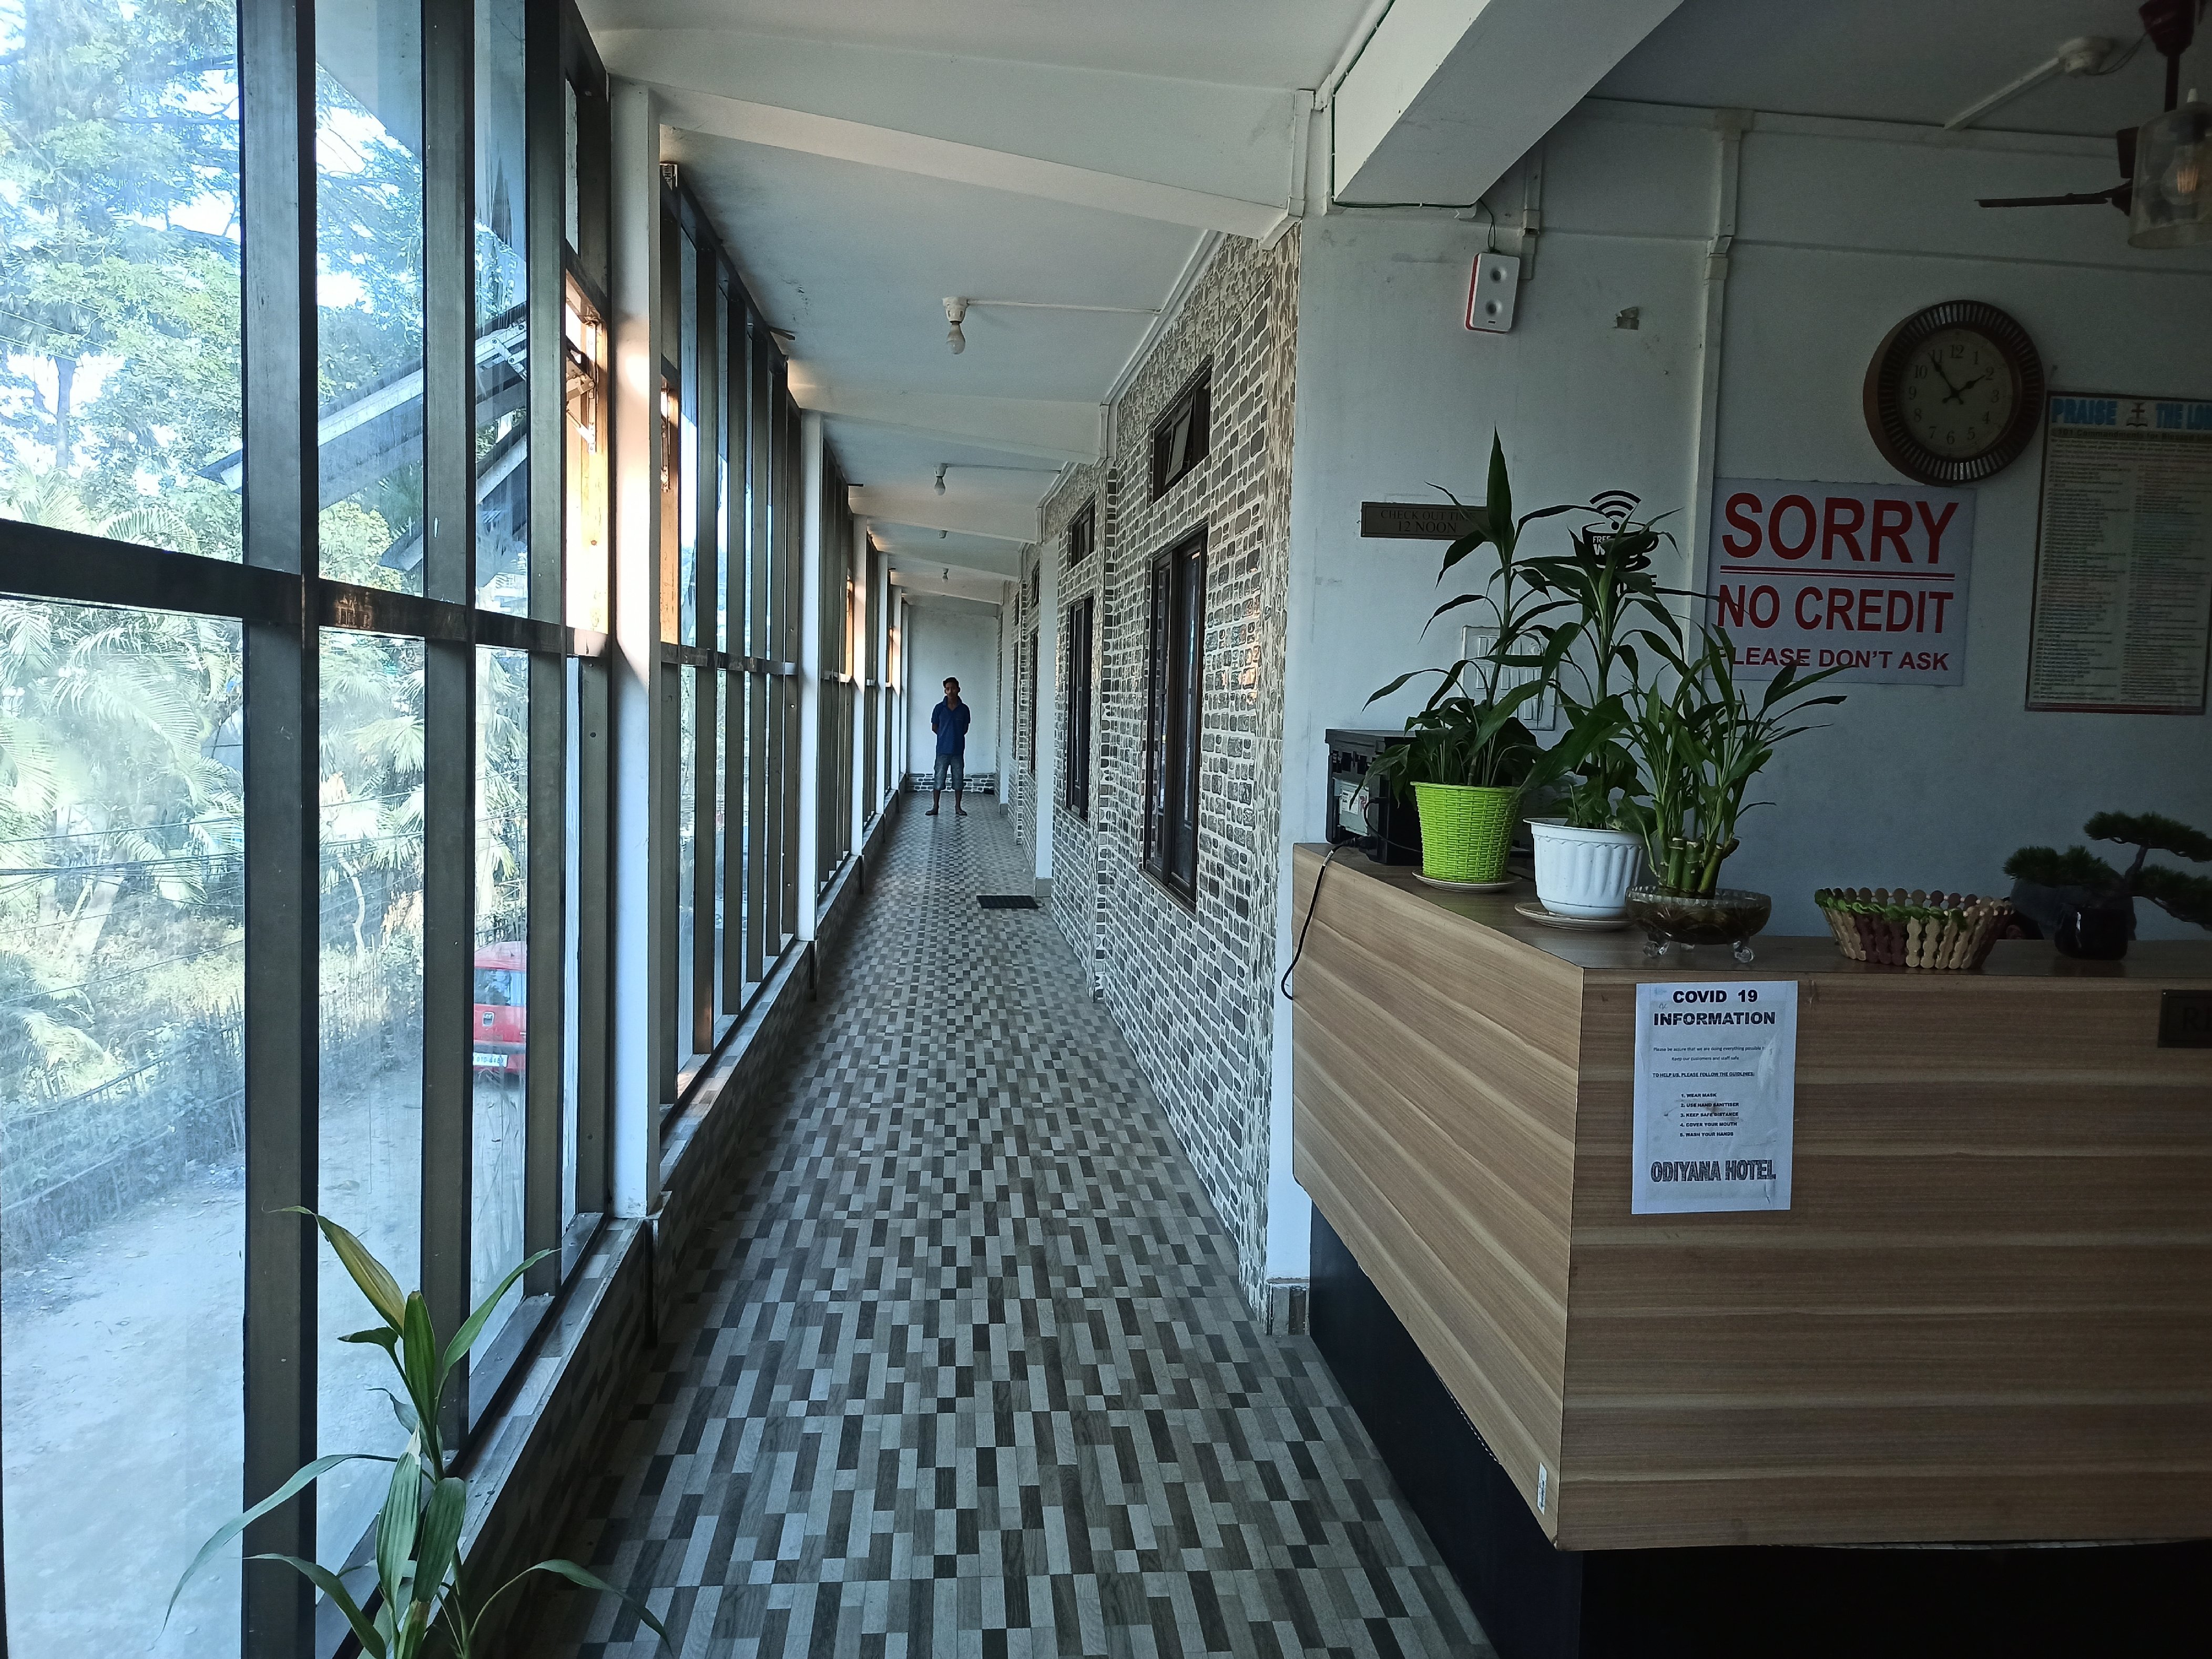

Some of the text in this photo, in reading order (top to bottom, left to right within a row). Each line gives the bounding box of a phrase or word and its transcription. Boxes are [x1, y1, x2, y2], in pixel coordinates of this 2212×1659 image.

[1950, 344, 1964, 358] 12
[1914, 364, 1928, 379] 10
[2051, 398, 2117, 425] PRAISE
[2156, 403, 2183, 429] THE
[2077, 429, 2144, 439] Commandments
[1380, 510, 1421, 520] CHECK
[1422, 511, 1445, 521] OUT
[1399, 521, 1456, 533] 12 NOON
[1722, 492, 1959, 564] SORRY
[1718, 585, 1953, 633] NO CREDIT
[1819, 649, 1893, 669] DON'T
[1898, 652, 1949, 670] ASK
[1673, 990, 1727, 1003] COVID
[1738, 989, 1758, 1003] 19
[1654, 1011, 1776, 1026] INFORMATION
[1650, 1159, 1776, 1183] ODIYANA HOTEL
